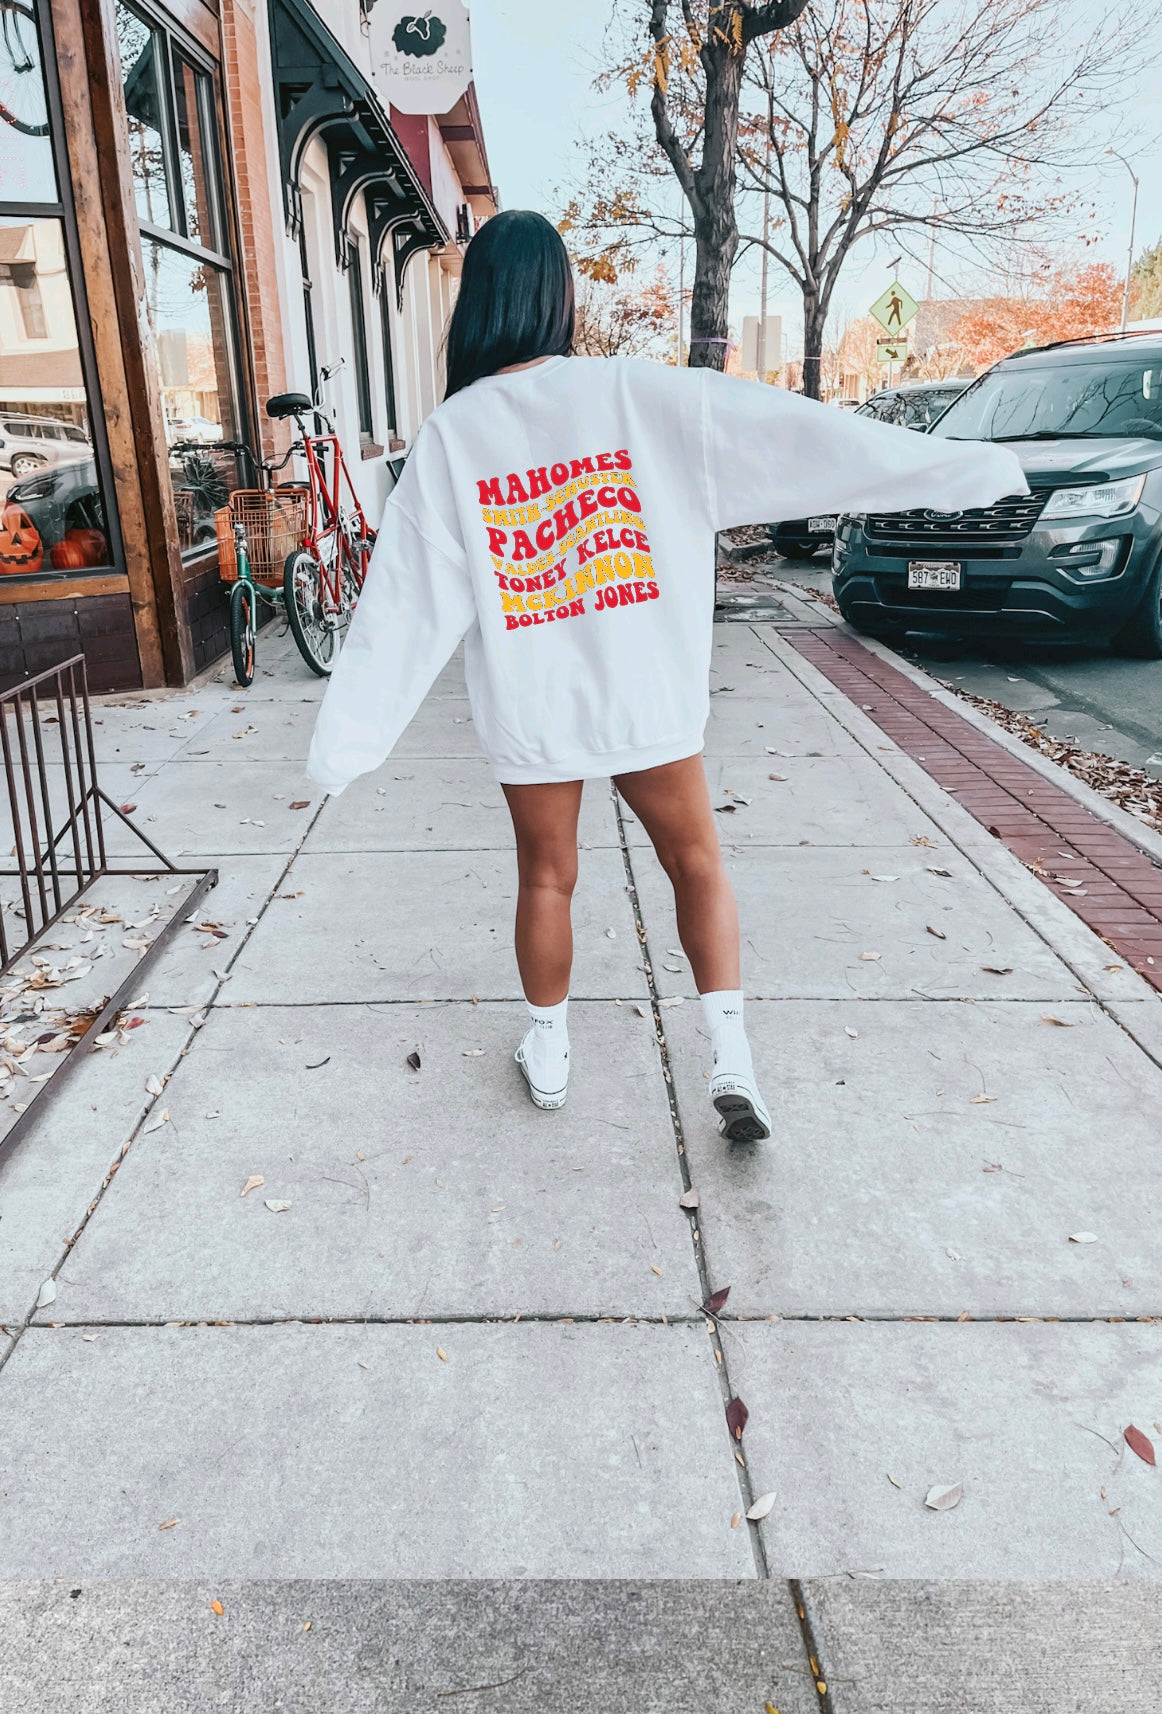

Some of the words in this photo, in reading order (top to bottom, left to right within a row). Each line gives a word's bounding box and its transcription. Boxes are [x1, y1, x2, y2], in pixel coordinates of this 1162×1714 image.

[380, 63, 399, 76] The
[403, 62, 434, 76] Black
[437, 60, 464, 76] Sheep
[476, 449, 633, 506] MAHOMES
[481, 472, 637, 527] SMITH-SCHUSTER
[485, 486, 642, 561] PACHECO
[490, 510, 647, 576] VALDES-SCANTLING
[493, 557, 567, 593] TONEY
[575, 528, 651, 565] KELCE
[499, 552, 656, 613] MCKINNON
[912, 571, 929, 584] 587
[504, 598, 586, 631] BOLTON
[594, 581, 660, 612] JONES
